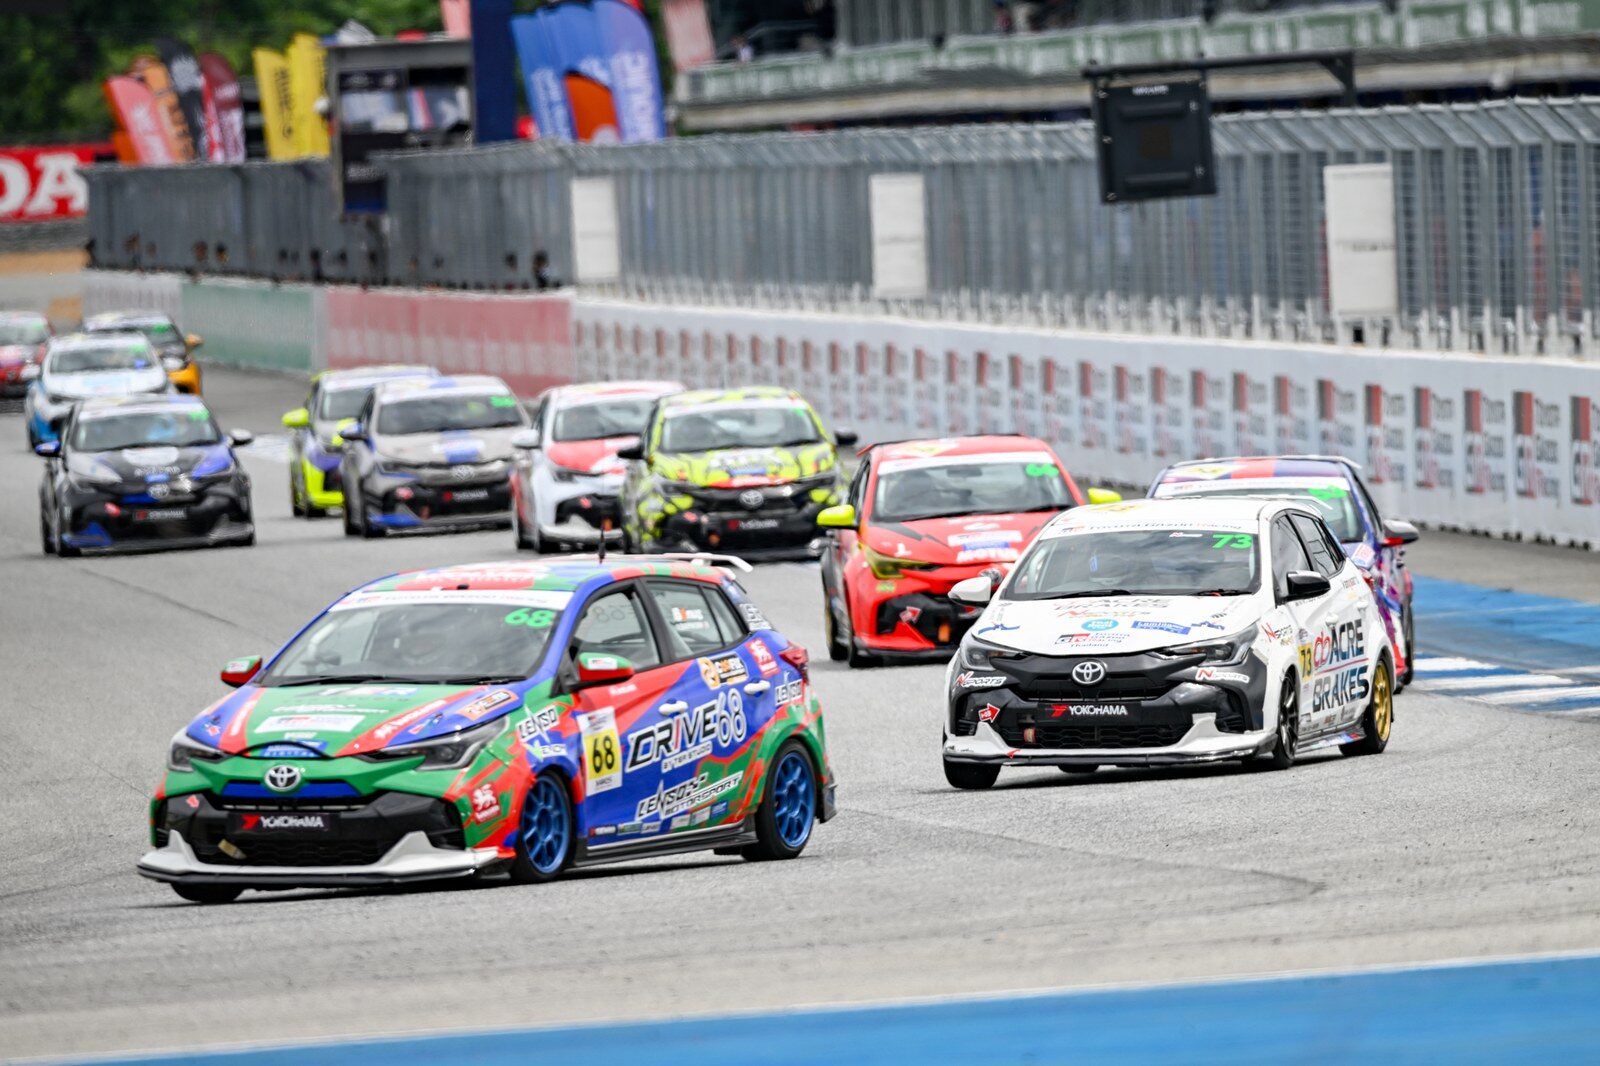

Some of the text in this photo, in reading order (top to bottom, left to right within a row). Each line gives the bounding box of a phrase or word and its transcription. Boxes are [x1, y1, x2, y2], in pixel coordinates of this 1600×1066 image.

[1212, 534, 1254, 549] 73
[504, 607, 555, 627] 68
[1329, 618, 1365, 665] ACRE
[1301, 647, 1312, 678] 73
[1312, 665, 1370, 713] BRAKES
[1069, 705, 1128, 715] YOKOHAMA
[592, 736, 615, 773] 68
[664, 777, 738, 817] MOTORSPORT
[260, 815, 325, 827] YOKOHAMA
